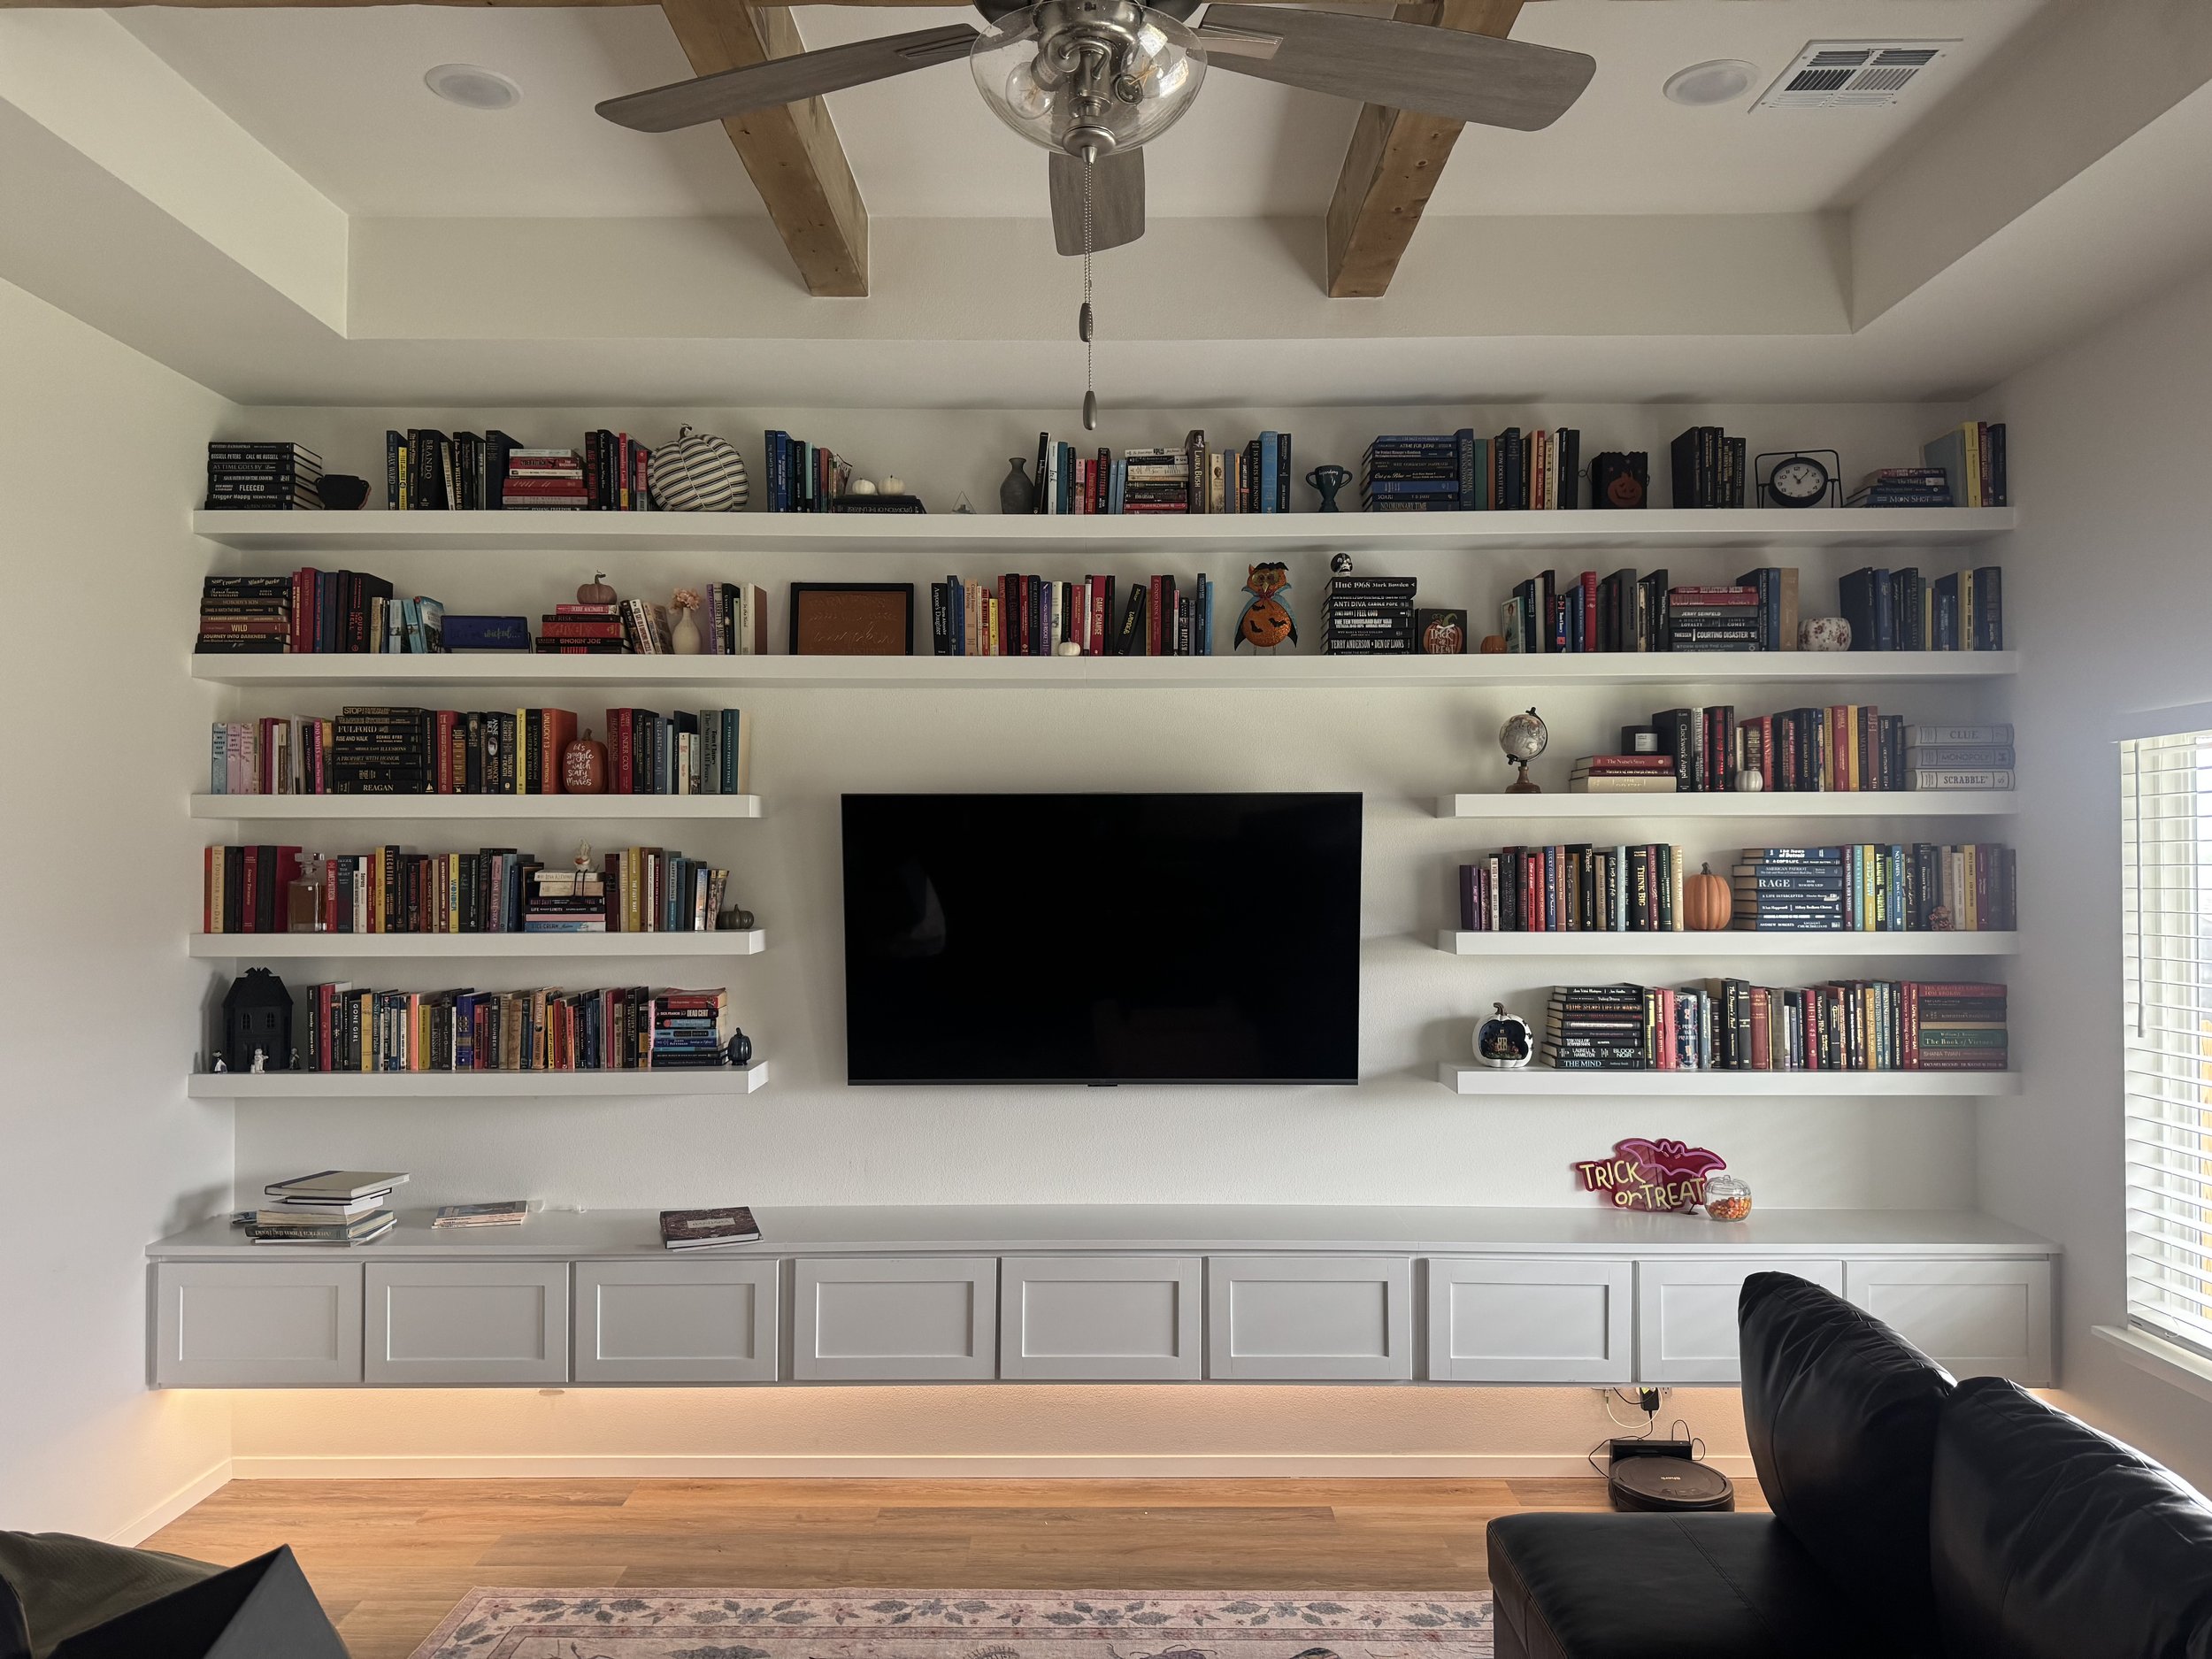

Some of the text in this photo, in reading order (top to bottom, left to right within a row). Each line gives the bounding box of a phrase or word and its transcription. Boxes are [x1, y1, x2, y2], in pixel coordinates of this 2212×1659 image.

[1345, 639, 1370, 649] ANDERSON
[1950, 731, 1978, 739] CLUE
[1942, 753, 1989, 761] MONOPOLY
[1759, 879, 1790, 887] RAGE
[1638, 892, 1646, 906] BIG
[1579, 1160, 1646, 1189] TRICK
[1615, 1177, 1705, 1210] or TREAT
